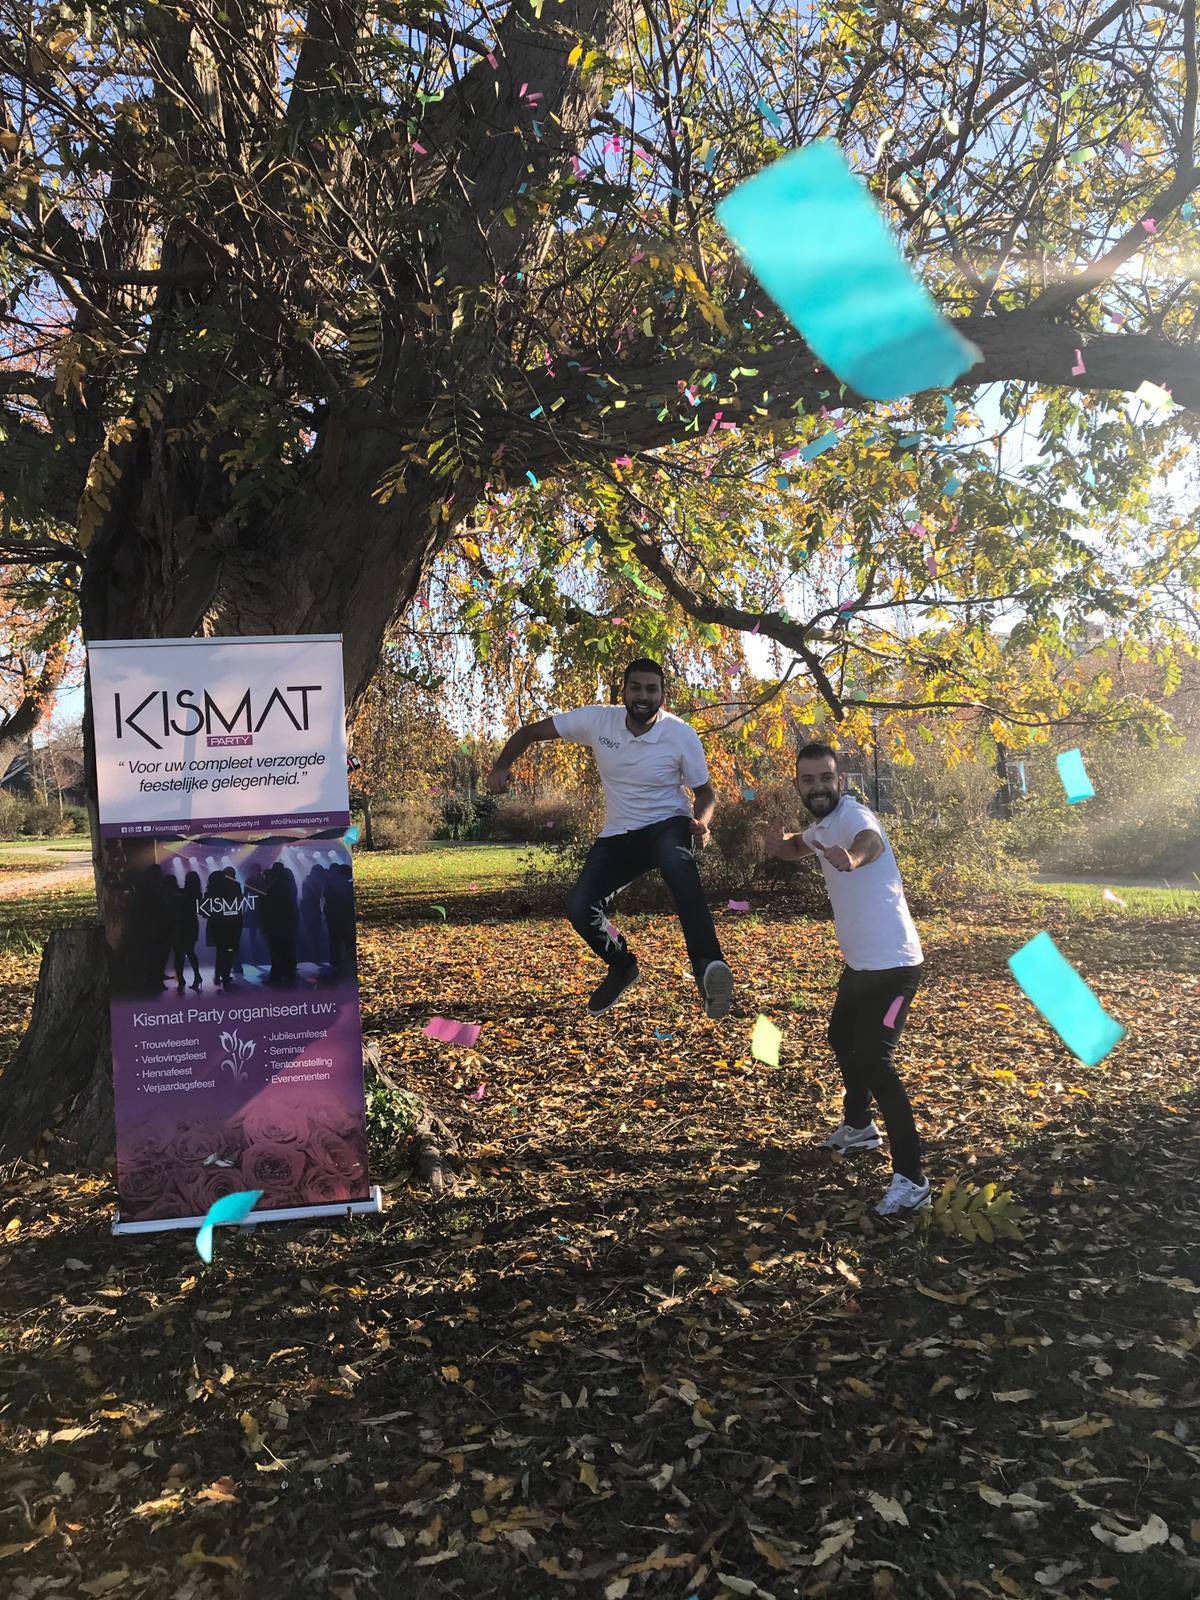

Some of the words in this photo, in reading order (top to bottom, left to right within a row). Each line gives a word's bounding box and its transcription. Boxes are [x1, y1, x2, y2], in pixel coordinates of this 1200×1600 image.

[114, 685, 322, 750] KISMAT
[210, 736, 251, 746] PARTY
[129, 759, 163, 774] Voor
[165, 760, 187, 773] uw
[189, 755, 254, 774] compleet
[256, 752, 326, 771] verzorgde
[139, 774, 209, 793] feestelijke
[202, 819, 260, 830] www.kismatparty.nl
[270, 816, 330, 826] info@kismatparty.nl
[196, 895, 259, 917] KISMAT
[133, 1011, 184, 1027] Kismat
[187, 1008, 225, 1024] Party
[228, 1002, 308, 1022] organiseert
[311, 1002, 337, 1014] uw:
[269, 1029, 328, 1041] Jubileumfeest
[140, 1037, 200, 1050] Trouwfeesten
[269, 1045, 306, 1056] Seminar
[141, 1051, 207, 1065] Verlovingsfeest
[270, 1057, 333, 1070] Tentoonstelling
[142, 1066, 193, 1078] Hennafeest
[271, 1072, 330, 1084] Evenementen
[143, 1079, 216, 1094] Verjaardagsfeest
